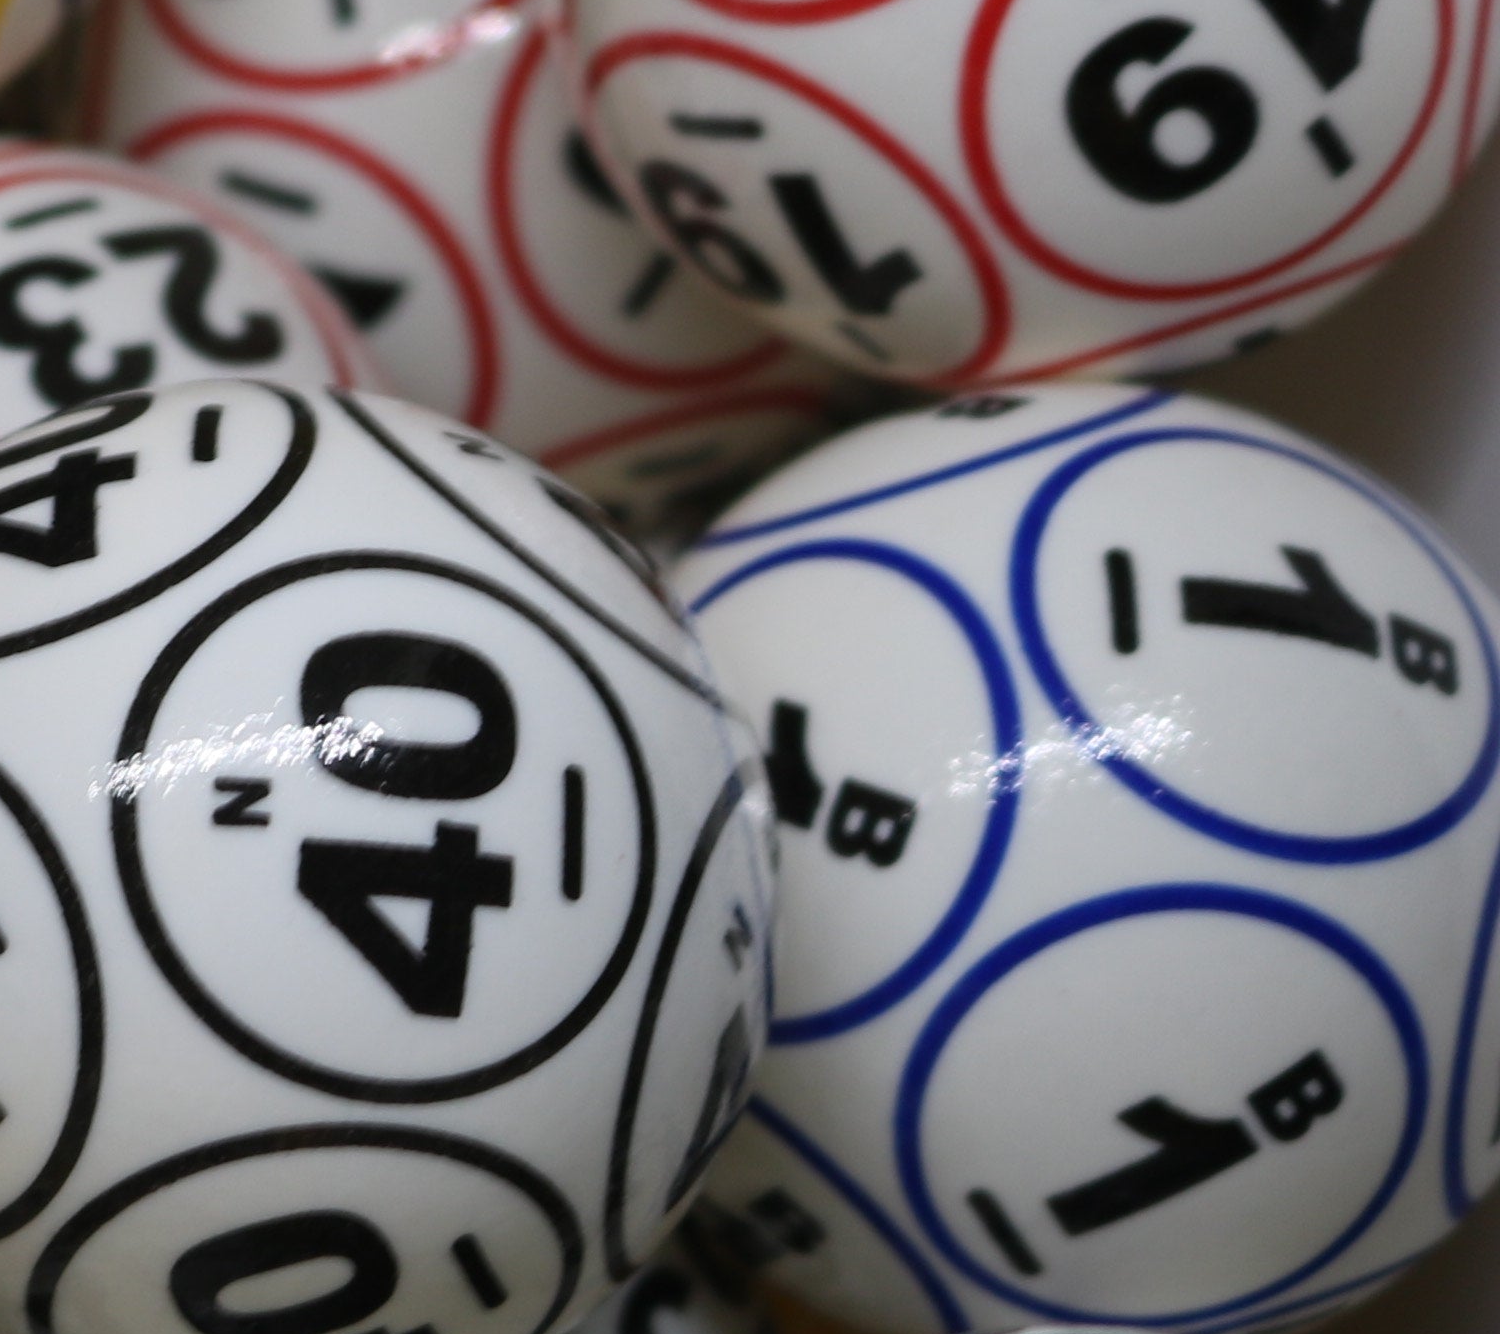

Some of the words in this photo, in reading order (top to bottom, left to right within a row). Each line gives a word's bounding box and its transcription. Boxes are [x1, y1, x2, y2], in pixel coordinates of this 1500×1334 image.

[636, 160, 928, 318] 19
[1180, 543, 1384, 660] 1
[1386, 610, 1460, 699] B
[211, 774, 274, 829] N
[297, 628, 517, 1021] 40
[825, 776, 918, 870] B
[1244, 1048, 1346, 1144] B
[1044, 1093, 1261, 1239] 1
